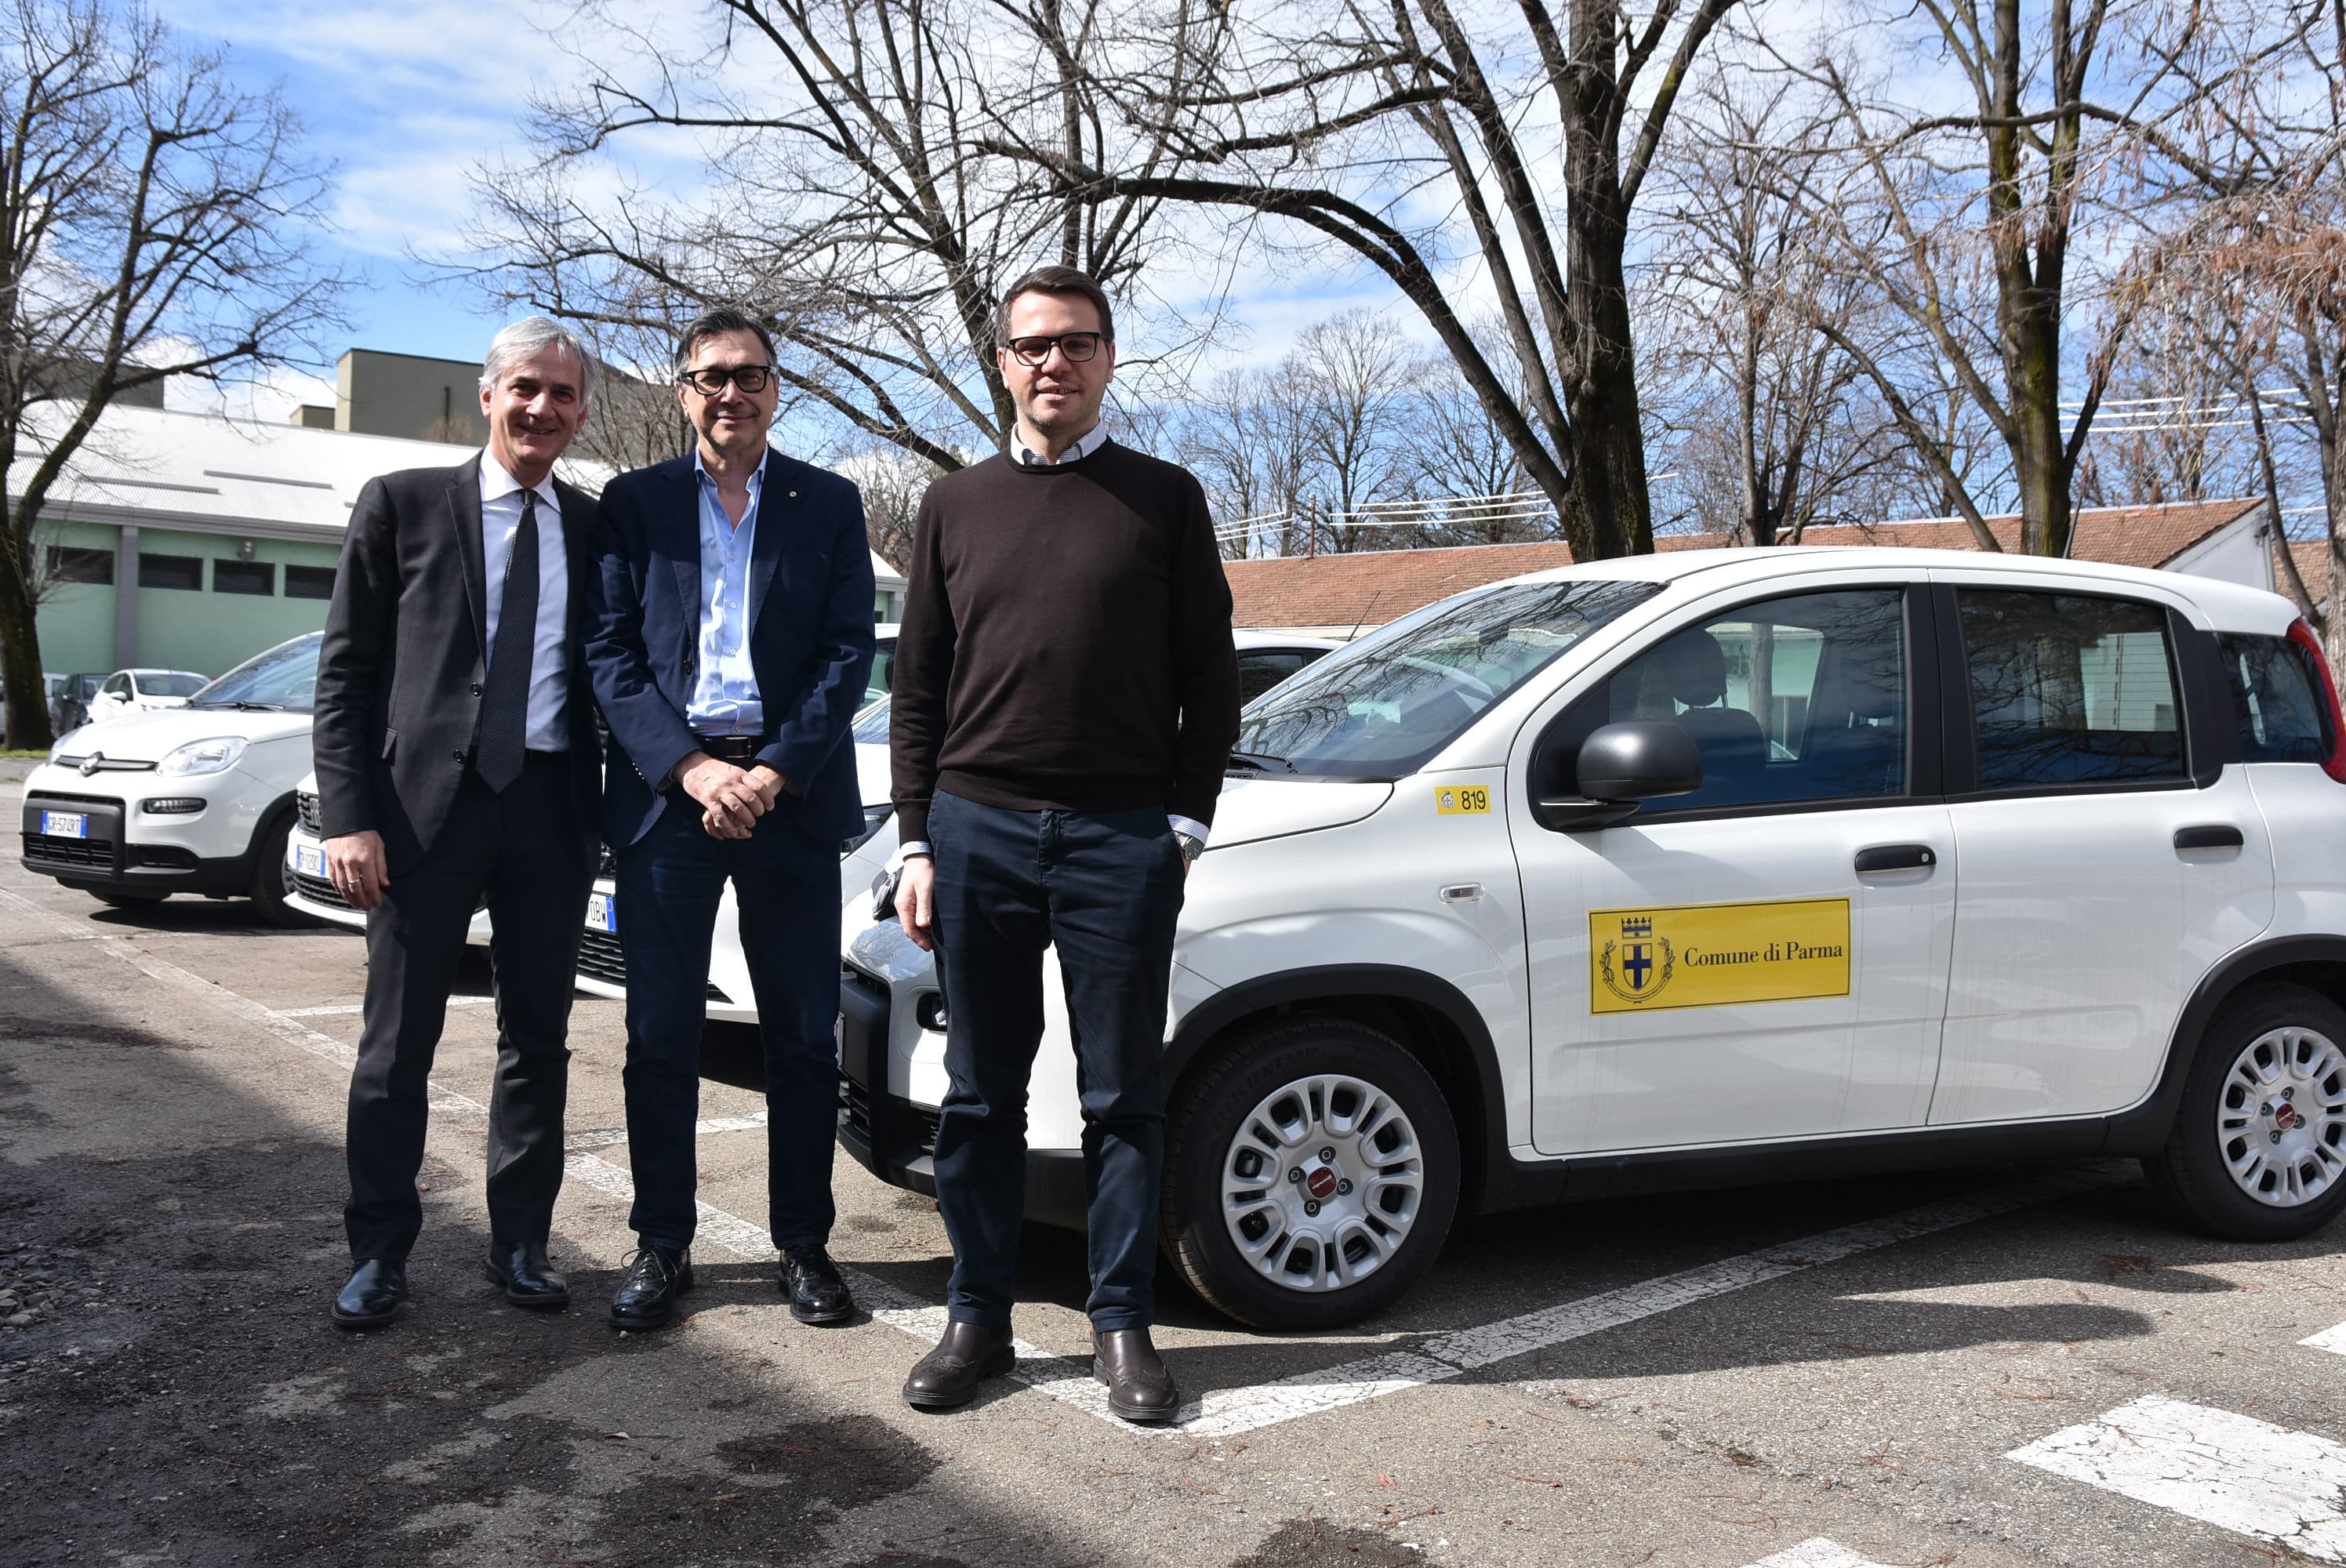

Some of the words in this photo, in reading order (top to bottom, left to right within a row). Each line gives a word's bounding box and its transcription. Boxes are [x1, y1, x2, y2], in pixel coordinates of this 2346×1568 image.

[1461, 789, 1487, 811] 819
[586, 900, 607, 924] 0BW
[1684, 947, 1760, 967] Comune
[1763, 942, 1781, 962] di
[1785, 941, 1844, 960] Parma
